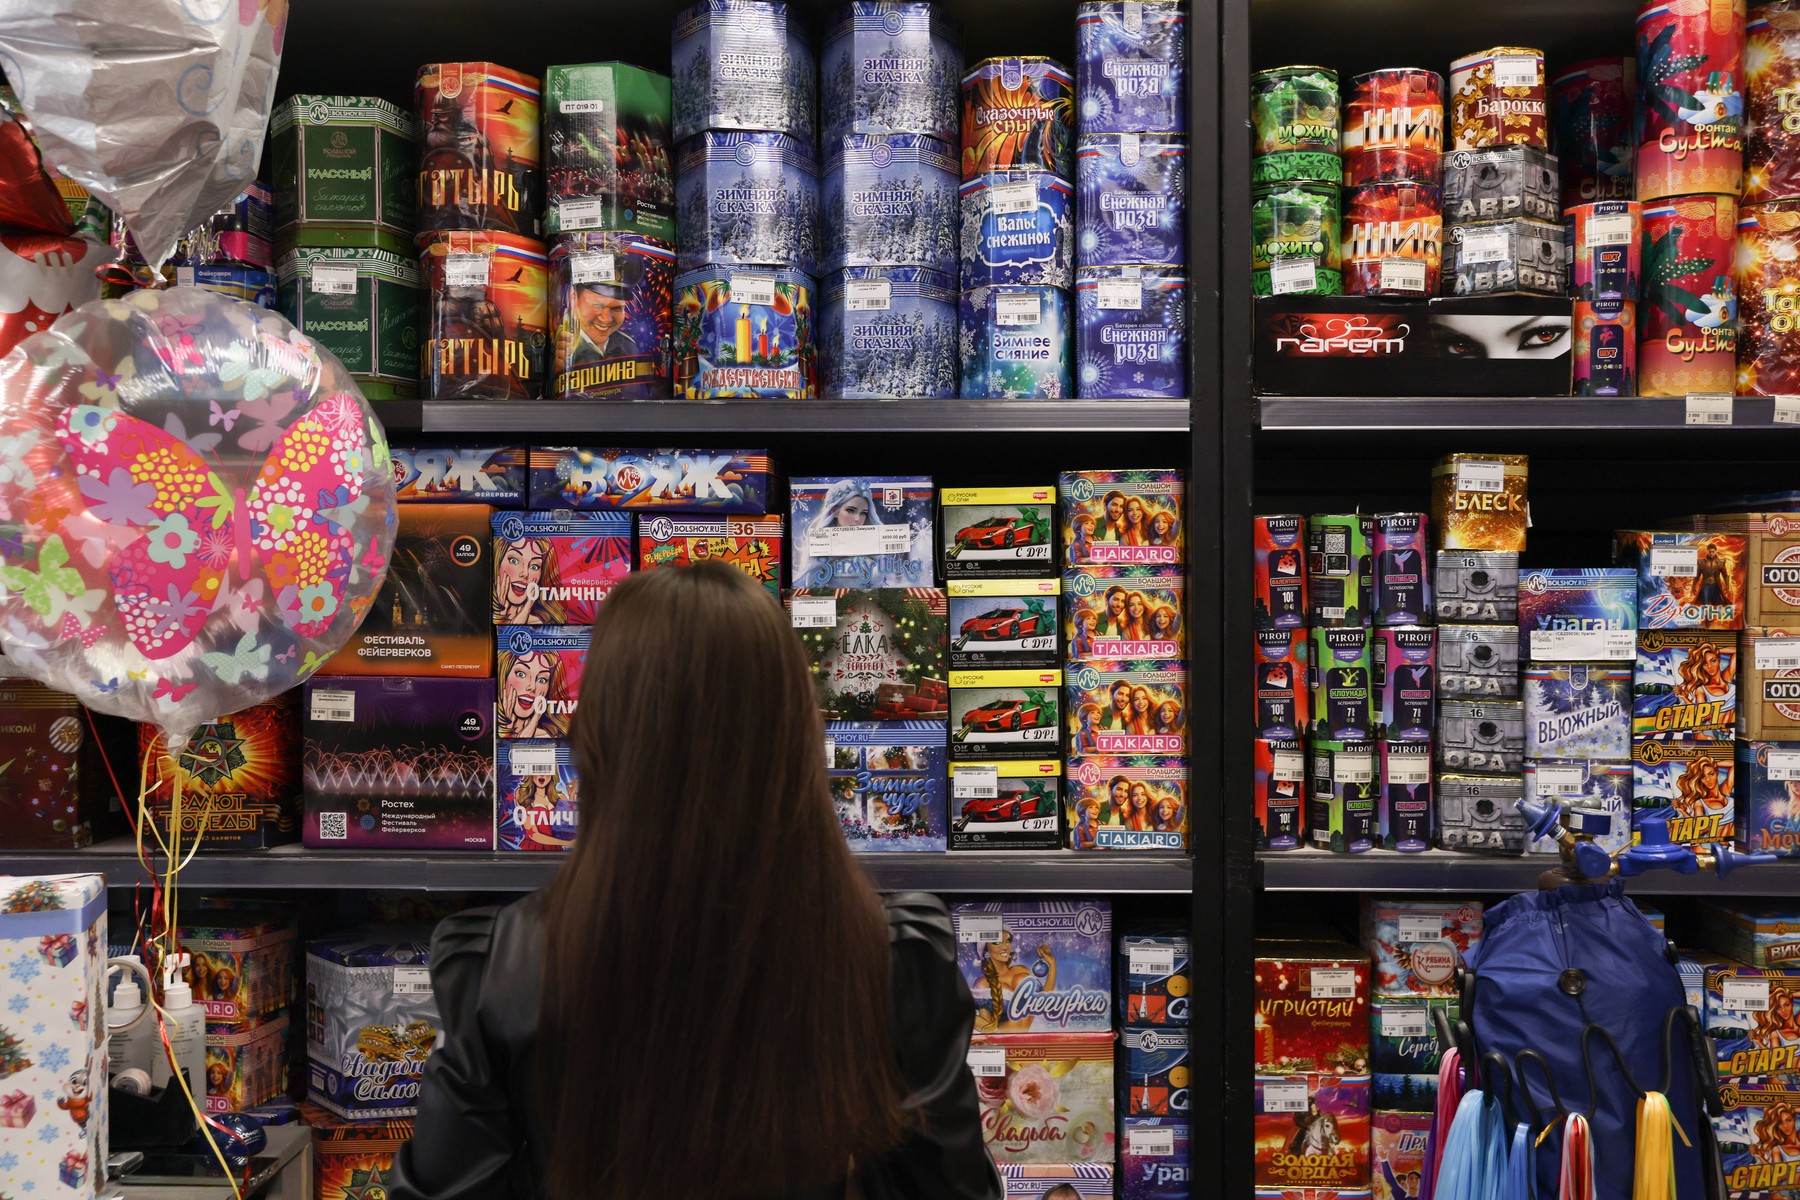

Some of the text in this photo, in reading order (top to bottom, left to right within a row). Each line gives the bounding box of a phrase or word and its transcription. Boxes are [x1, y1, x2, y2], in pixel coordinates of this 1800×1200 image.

[720, 54, 782, 66] ЗИМНЯЯ
[863, 58, 924, 70] ЗИМНЯЯ
[721, 67, 780, 80] СКАЗКА
[1103, 62, 1168, 76] Снежная
[864, 71, 923, 84] СКАЗКА
[1116, 77, 1160, 97] роза
[1278, 123, 1338, 139] МОХИТО
[1694, 124, 1737, 134] Фонтан
[307, 167, 372, 180] КЛАССНЫЙ
[716, 188, 777, 200] ЗИМНЯЯ
[852, 190, 912, 202] ЗИМНЯЯ
[718, 201, 776, 214] СКАЗКА
[854, 202, 912, 215] СКАЗКА
[1101, 194, 1166, 210] Снежная
[1599, 205, 1624, 213] PIROFF
[998, 216, 1036, 232] Вальс
[1115, 210, 1158, 230] роза
[986, 232, 1051, 249] снежинок
[1352, 221, 1440, 265] ШИК
[1256, 241, 1324, 258] МОХИТО
[1602, 252, 1620, 263] ШУТ
[392, 265, 404, 278] 19
[306, 318, 369, 331] КЛАССНЫЙ
[852, 324, 913, 336] ЗИМНЯЯ
[994, 333, 1052, 348] Зимнее
[1102, 328, 1168, 343] Снежная
[854, 337, 912, 350] СКАЗКА
[995, 349, 1050, 360] сияние
[1116, 343, 1158, 364] роза
[1598, 348, 1618, 358] ШУТ
[1455, 492, 1522, 512] БЛЕСК
[524, 525, 570, 533] BOLSHOY.RU
[733, 522, 754, 536] 36
[1270, 520, 1298, 528] PIROFF
[1380, 518, 1418, 528] PIROFF
[460, 544, 471, 552] 49
[1094, 550, 1174, 560] TAKARO
[1461, 558, 1476, 567] 16
[570, 578, 613, 586] Фейерверк
[1536, 614, 1622, 630] Ураган
[364, 636, 425, 645] ФЕСТИВАЛЬ
[1259, 632, 1291, 640] PIROFF
[1329, 634, 1365, 642] PIROFF
[1398, 633, 1432, 642] PIROFF
[1465, 633, 1479, 641] 16
[842, 632, 889, 654] ЁЛКА
[1096, 644, 1176, 654] TAKARO
[358, 648, 432, 657] ФЕЙЕРВЕРКОВ
[846, 661, 886, 671] ФЕЙЕРВЕРК
[1331, 690, 1367, 698] КЛОУНАДА
[1470, 708, 1484, 718] 16
[1655, 700, 1725, 731] СТАРТ
[464, 718, 476, 726] 49
[1538, 702, 1620, 744] ВЬЮЖНЫЙ
[1100, 738, 1180, 748] TAKARO
[1391, 746, 1428, 754] PIROFF
[852, 771, 937, 794] Зимнее
[1466, 786, 1480, 795] 16
[381, 800, 414, 808] Ростех
[882, 790, 937, 816] чудо
[1667, 814, 1724, 842] ТАРТ
[1100, 833, 1180, 845] TAKARO
[1018, 918, 1074, 926] BOLSHOY.RU
[1426, 956, 1451, 964] РЯБИНА
[1010, 979, 1106, 1028] Снегурка
[1730, 1045, 1799, 1076] СТАРТ
[980, 1107, 1069, 1152] Свадьба
[1272, 1152, 1354, 1168] ЗОЛОТАЯ
[1142, 1163, 1189, 1185] Ура
[1286, 1166, 1340, 1180] ОРДА
[1732, 1162, 1800, 1190] СТАРТ
